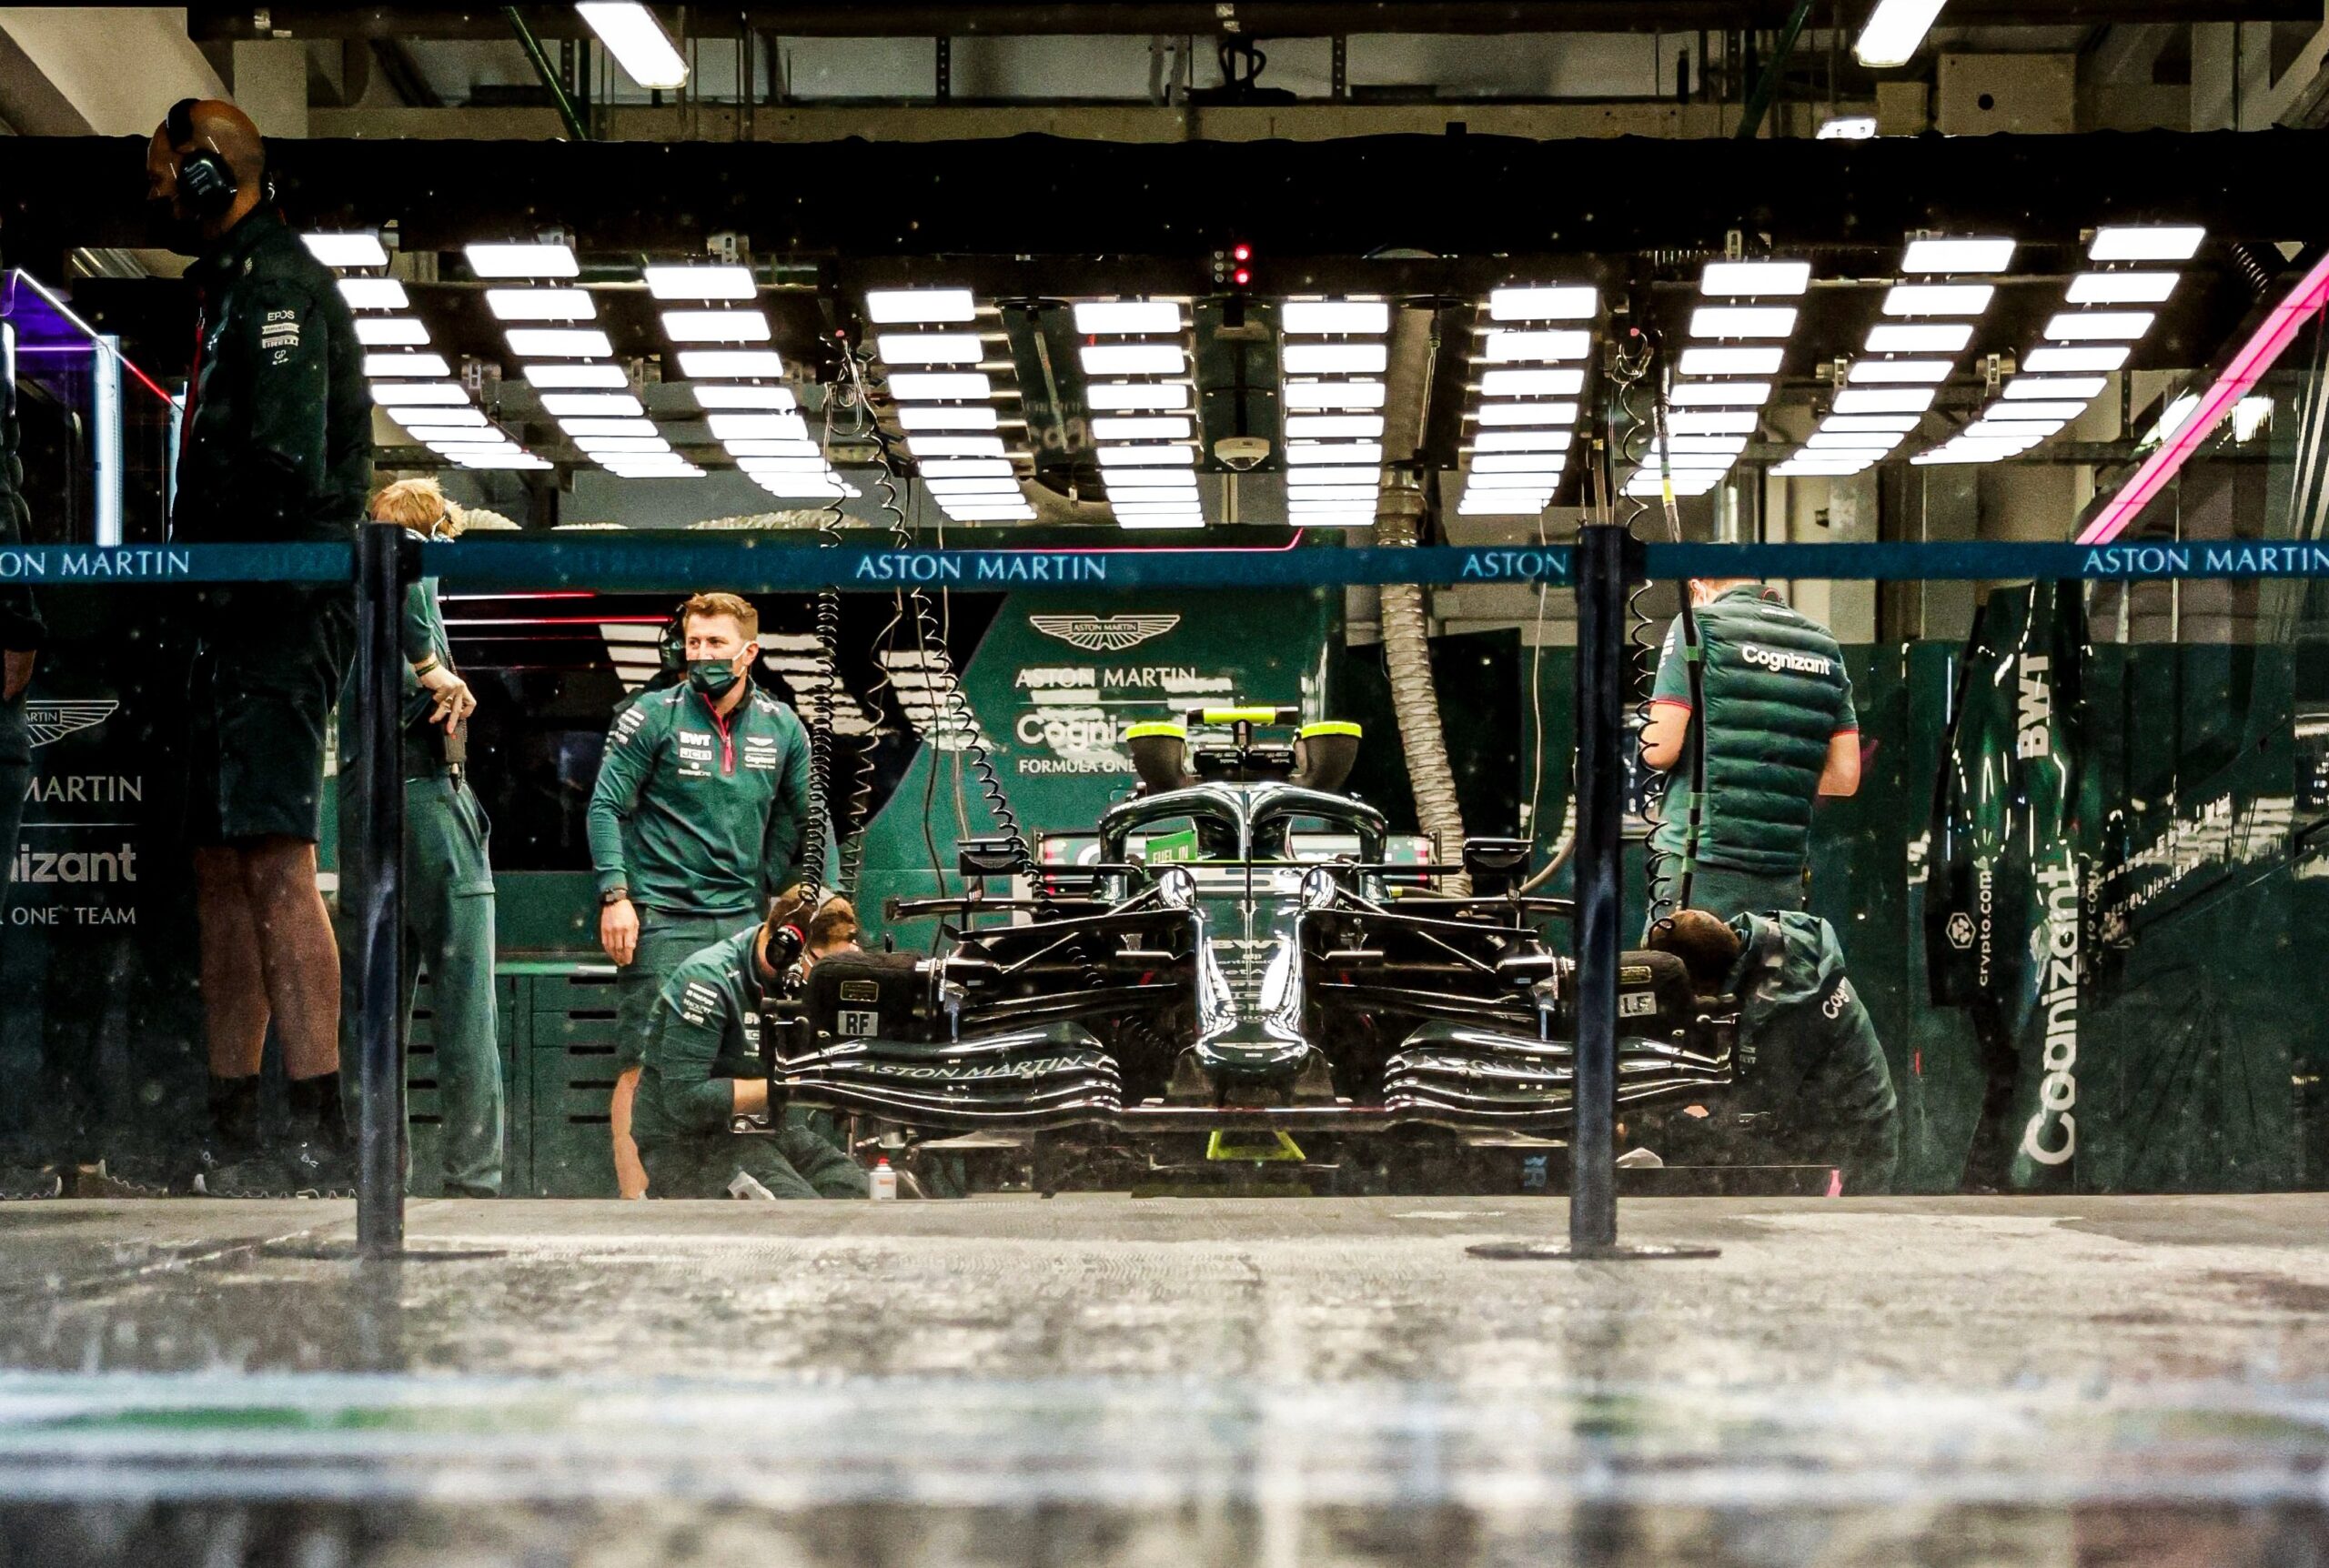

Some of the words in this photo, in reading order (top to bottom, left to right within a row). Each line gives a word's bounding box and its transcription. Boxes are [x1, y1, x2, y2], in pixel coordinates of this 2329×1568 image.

[267, 310, 295, 321] EPOS
[61, 551, 189, 576] MARTIN
[856, 555, 961, 580] ASTON
[977, 556, 1106, 580] MARTIN
[1462, 552, 1567, 578] ASTON
[2083, 548, 2189, 573] ASTON
[2206, 548, 2329, 571] MARTIN
[1741, 645, 1830, 676] Cognizant
[1015, 668, 1095, 689] ASTON
[1104, 667, 1196, 688] MARTIN
[26, 711, 58, 722] RTIN
[2017, 653, 2050, 759] BWT
[1016, 713, 1136, 752] Cogniz
[1019, 759, 1098, 773] FORMULA
[10, 843, 136, 882] izant
[1153, 849, 1173, 864] FUEL
[1178, 845, 1189, 860] IN
[12, 907, 59, 925] ONE
[74, 907, 136, 925] TEAM
[846, 1012, 871, 1034] RF
[861, 1064, 960, 1078] ASTON
[963, 1055, 1083, 1077] MARTIN
